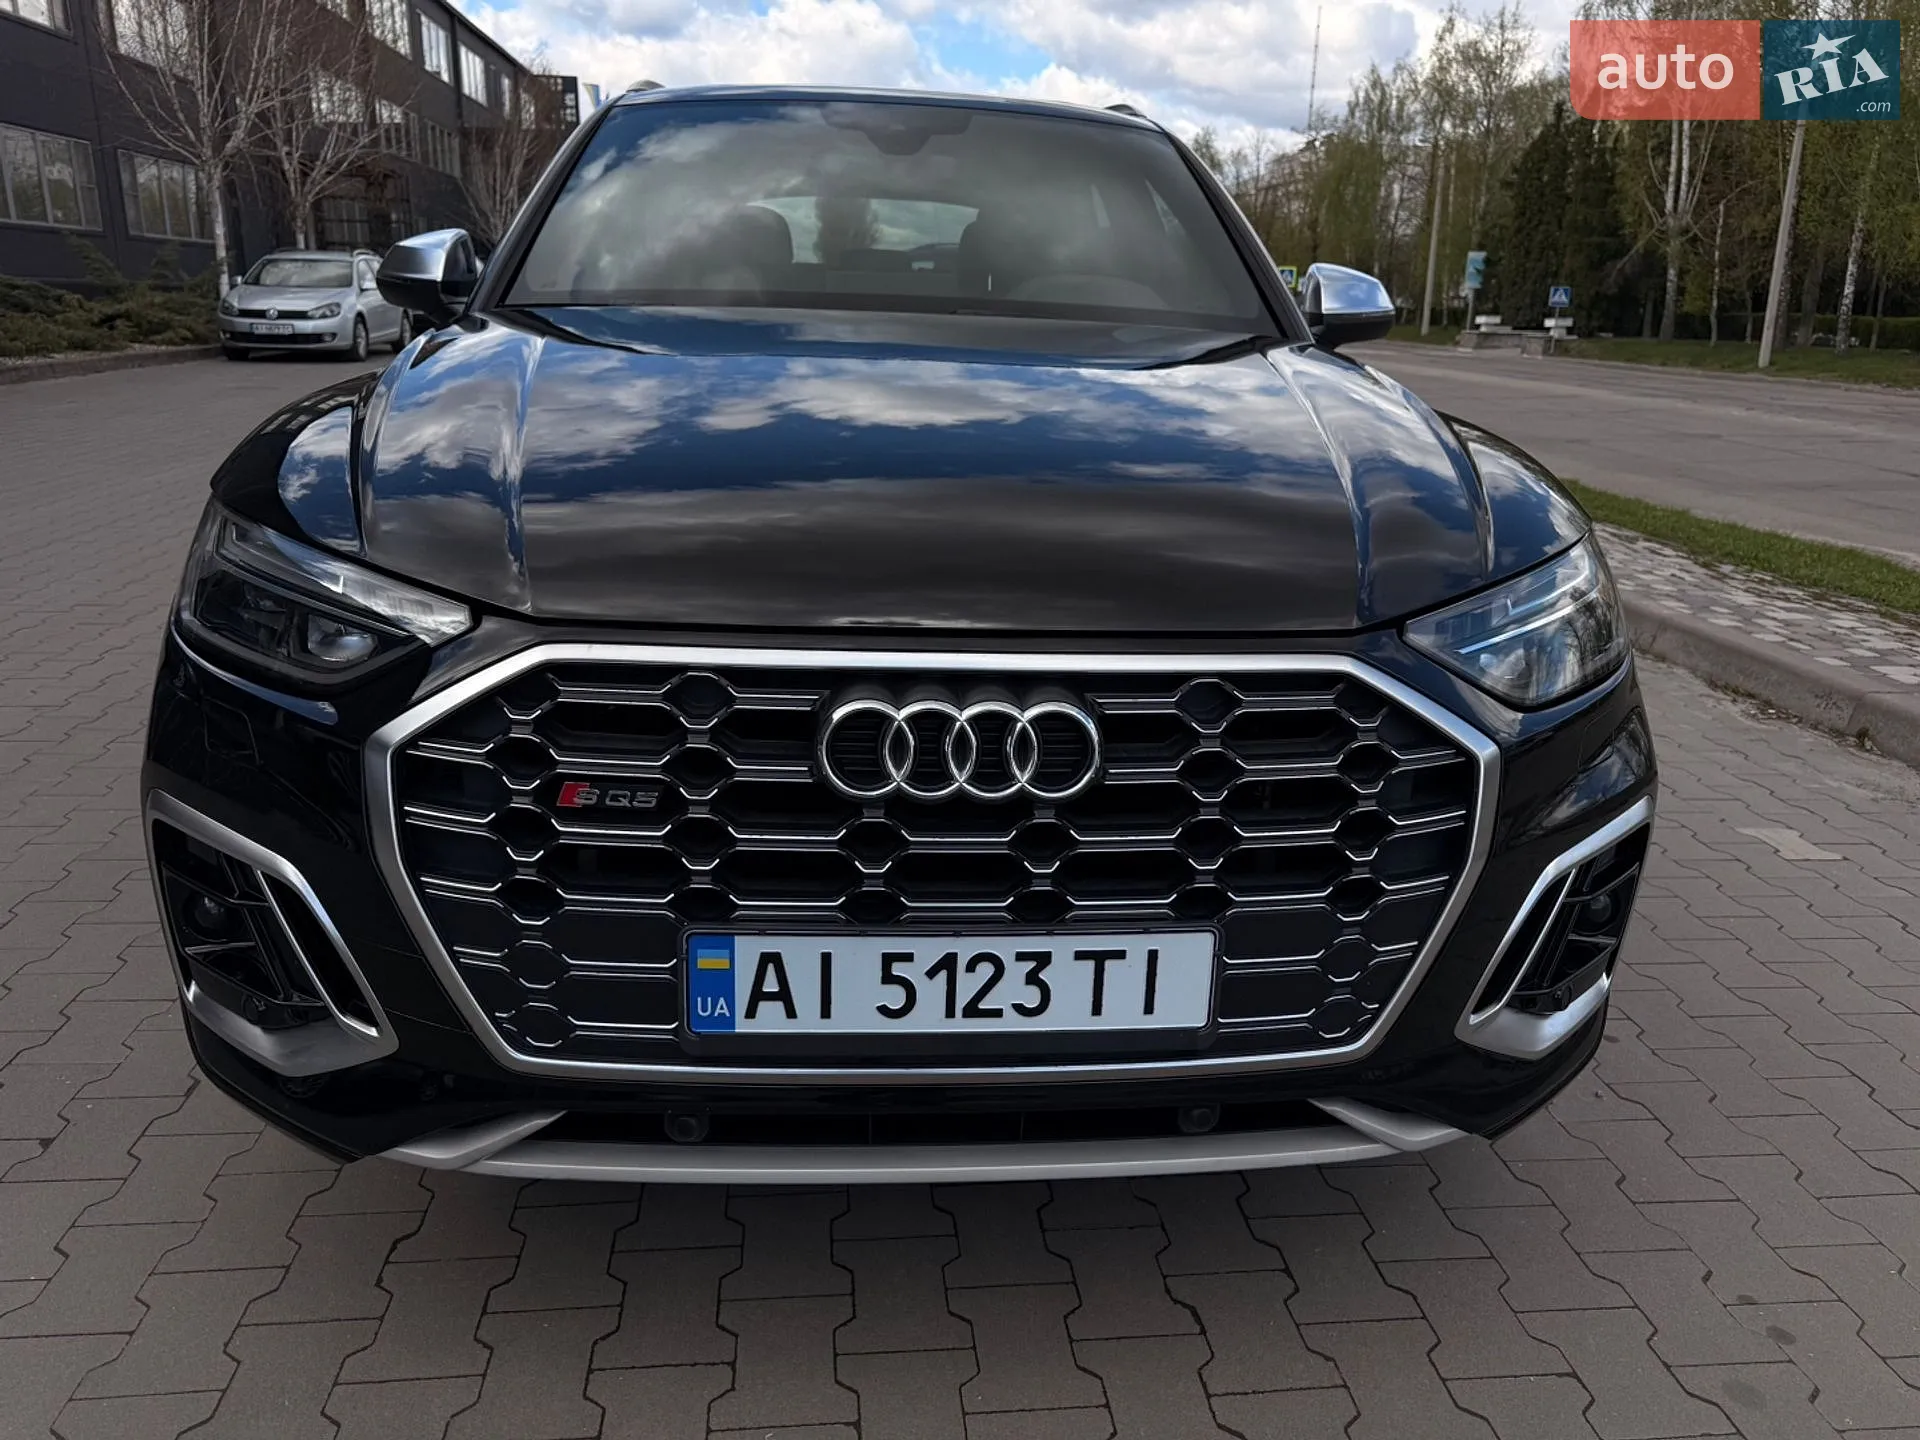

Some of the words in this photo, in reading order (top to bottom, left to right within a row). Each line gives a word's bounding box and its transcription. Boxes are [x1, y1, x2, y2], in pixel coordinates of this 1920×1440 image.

[697, 996, 731, 1018] UA
[743, 950, 833, 1020] AI
[874, 950, 1053, 1020] 5123
[1073, 948, 1159, 1017] TI
